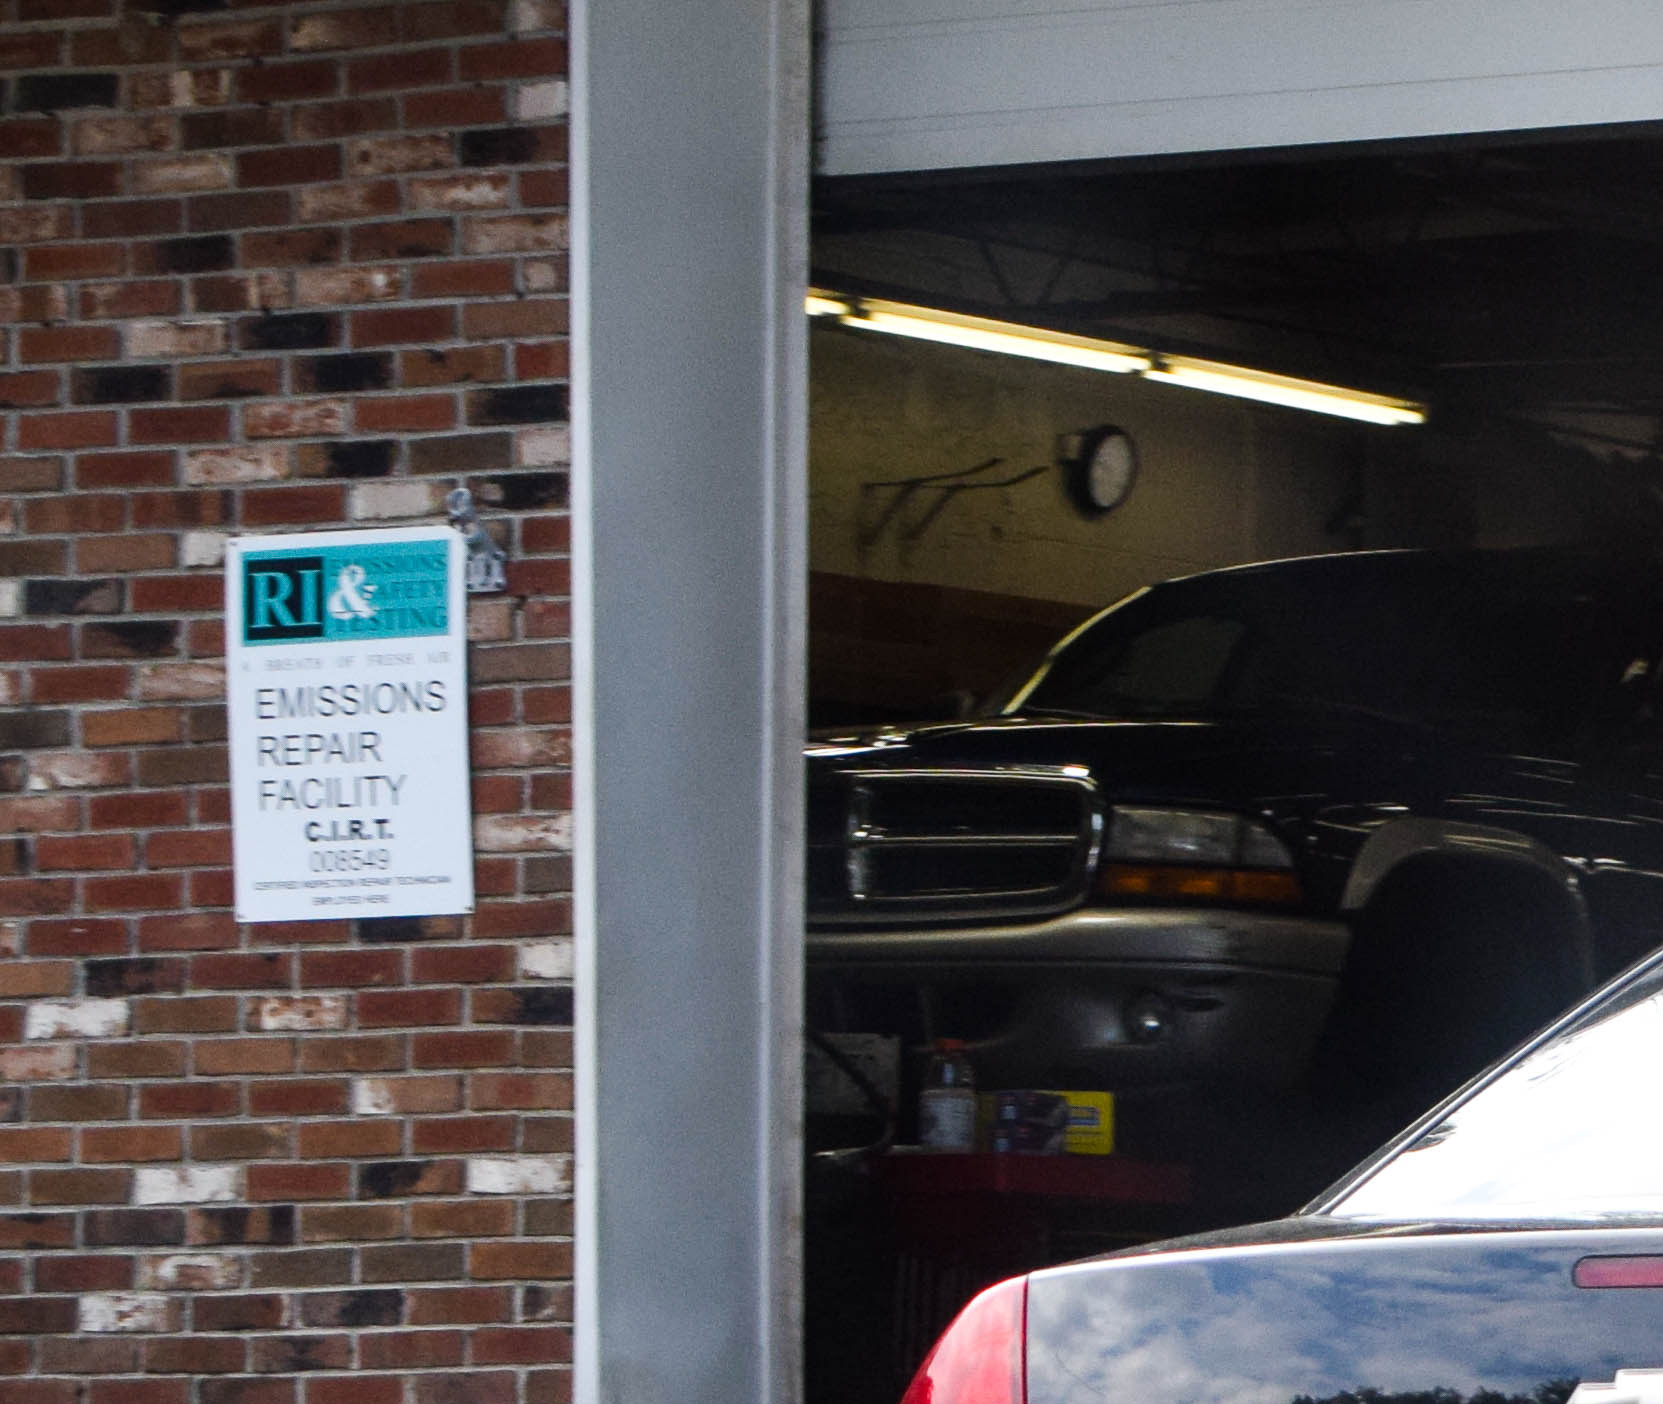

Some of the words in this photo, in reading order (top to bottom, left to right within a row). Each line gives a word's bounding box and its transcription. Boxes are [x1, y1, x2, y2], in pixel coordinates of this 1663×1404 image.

[247, 568, 323, 629] RI
[327, 563, 379, 620] &
[254, 680, 448, 720] EMISSIONS
[257, 731, 383, 768] REPAIR
[258, 774, 408, 811] FACILITY
[305, 818, 395, 842] C.I.R.T.
